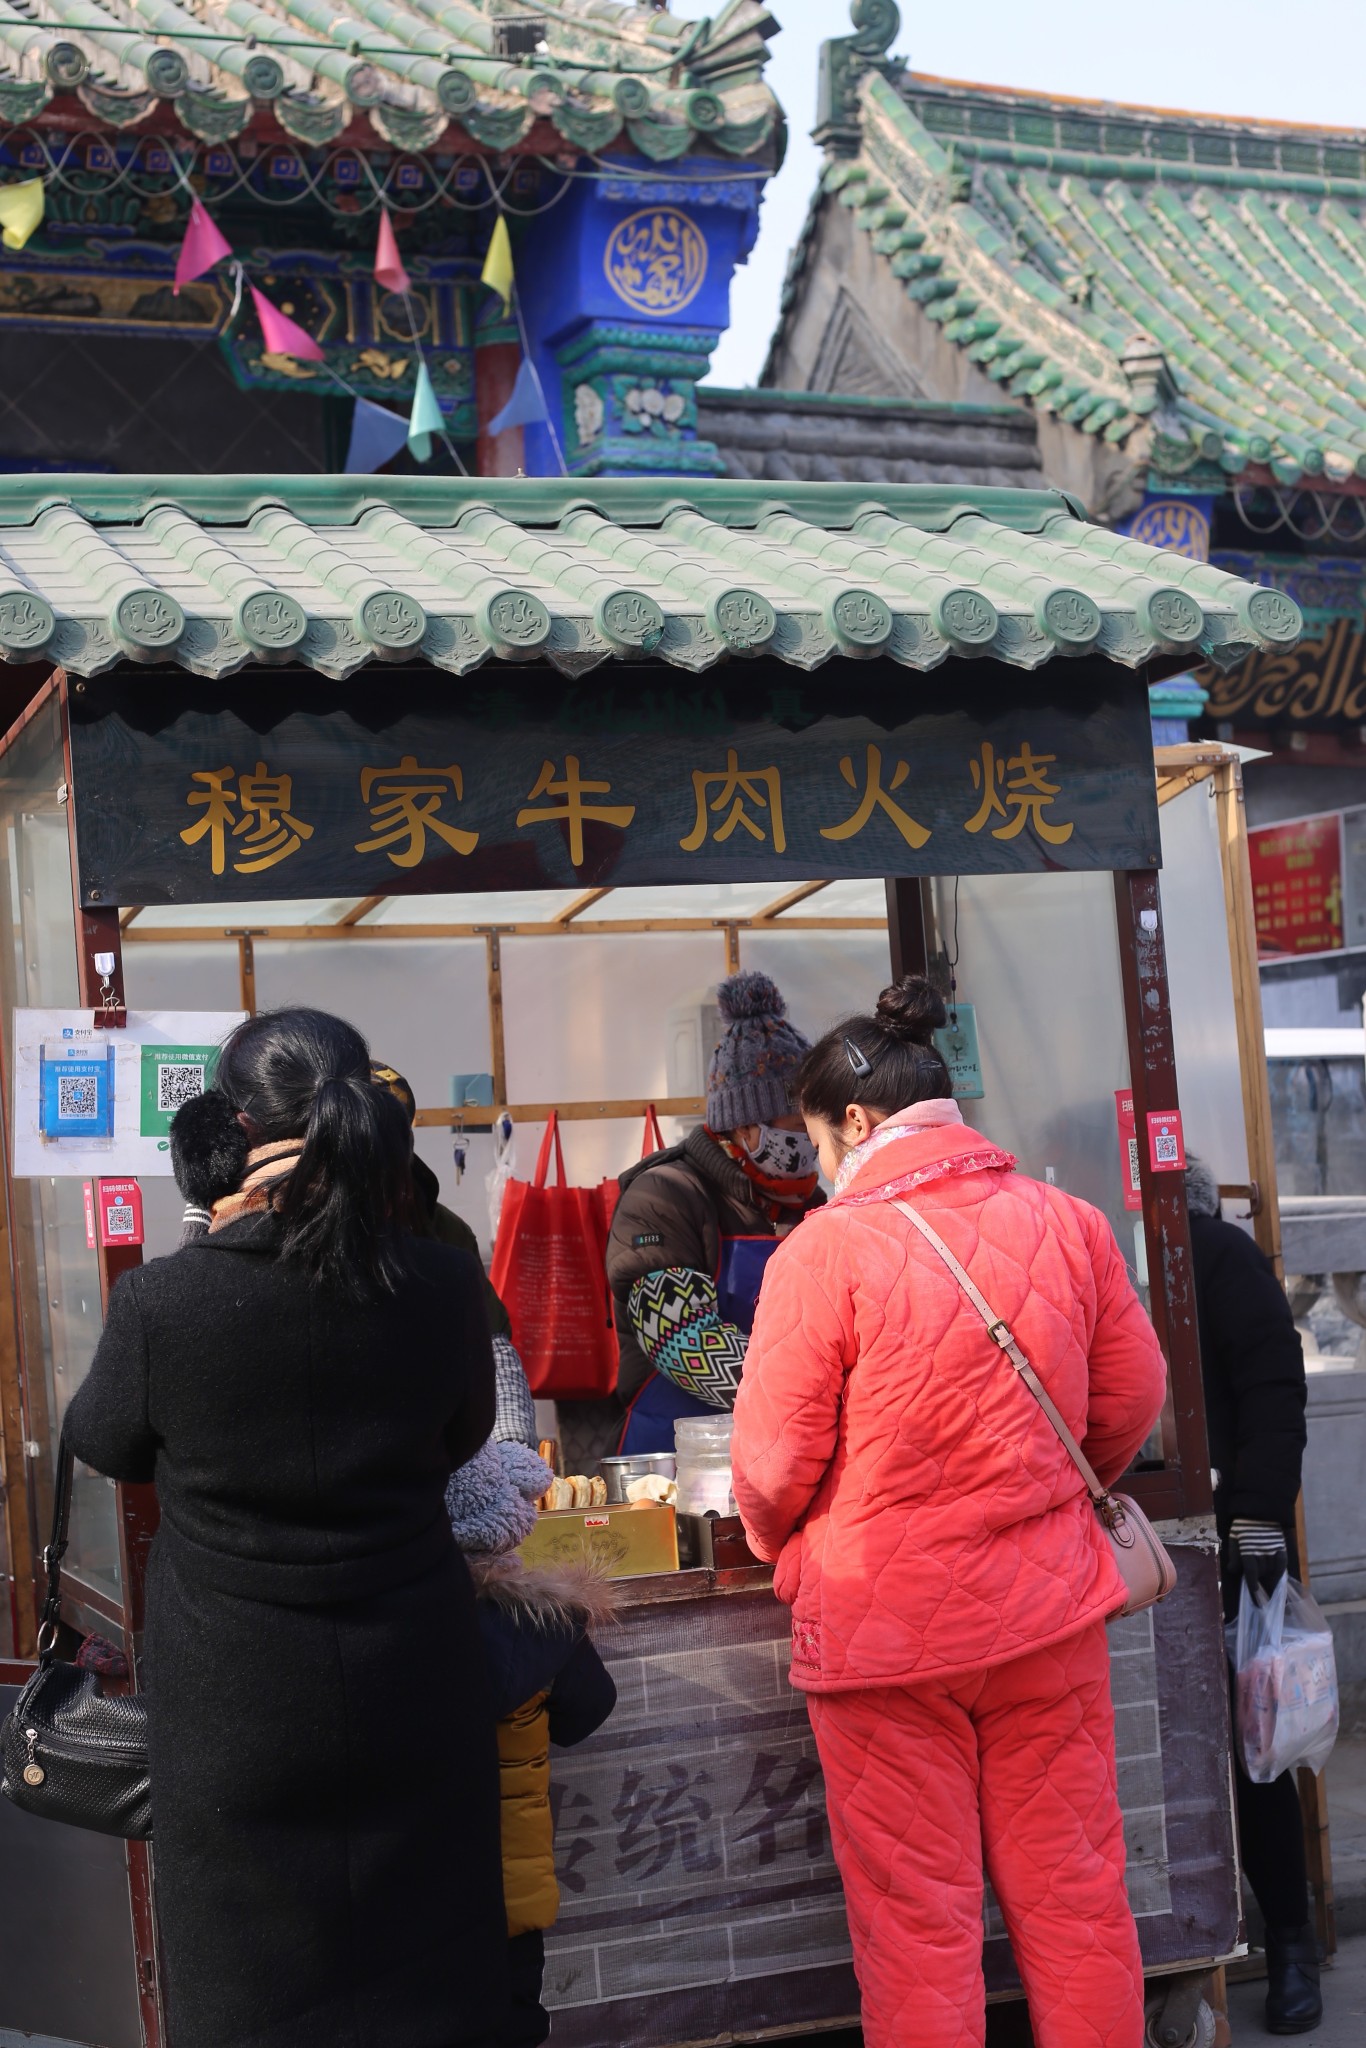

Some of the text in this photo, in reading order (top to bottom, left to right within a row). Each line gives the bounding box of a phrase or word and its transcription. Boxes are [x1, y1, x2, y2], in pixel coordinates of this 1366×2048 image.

[180, 742, 1075, 875] 穆家牛肉火烧
